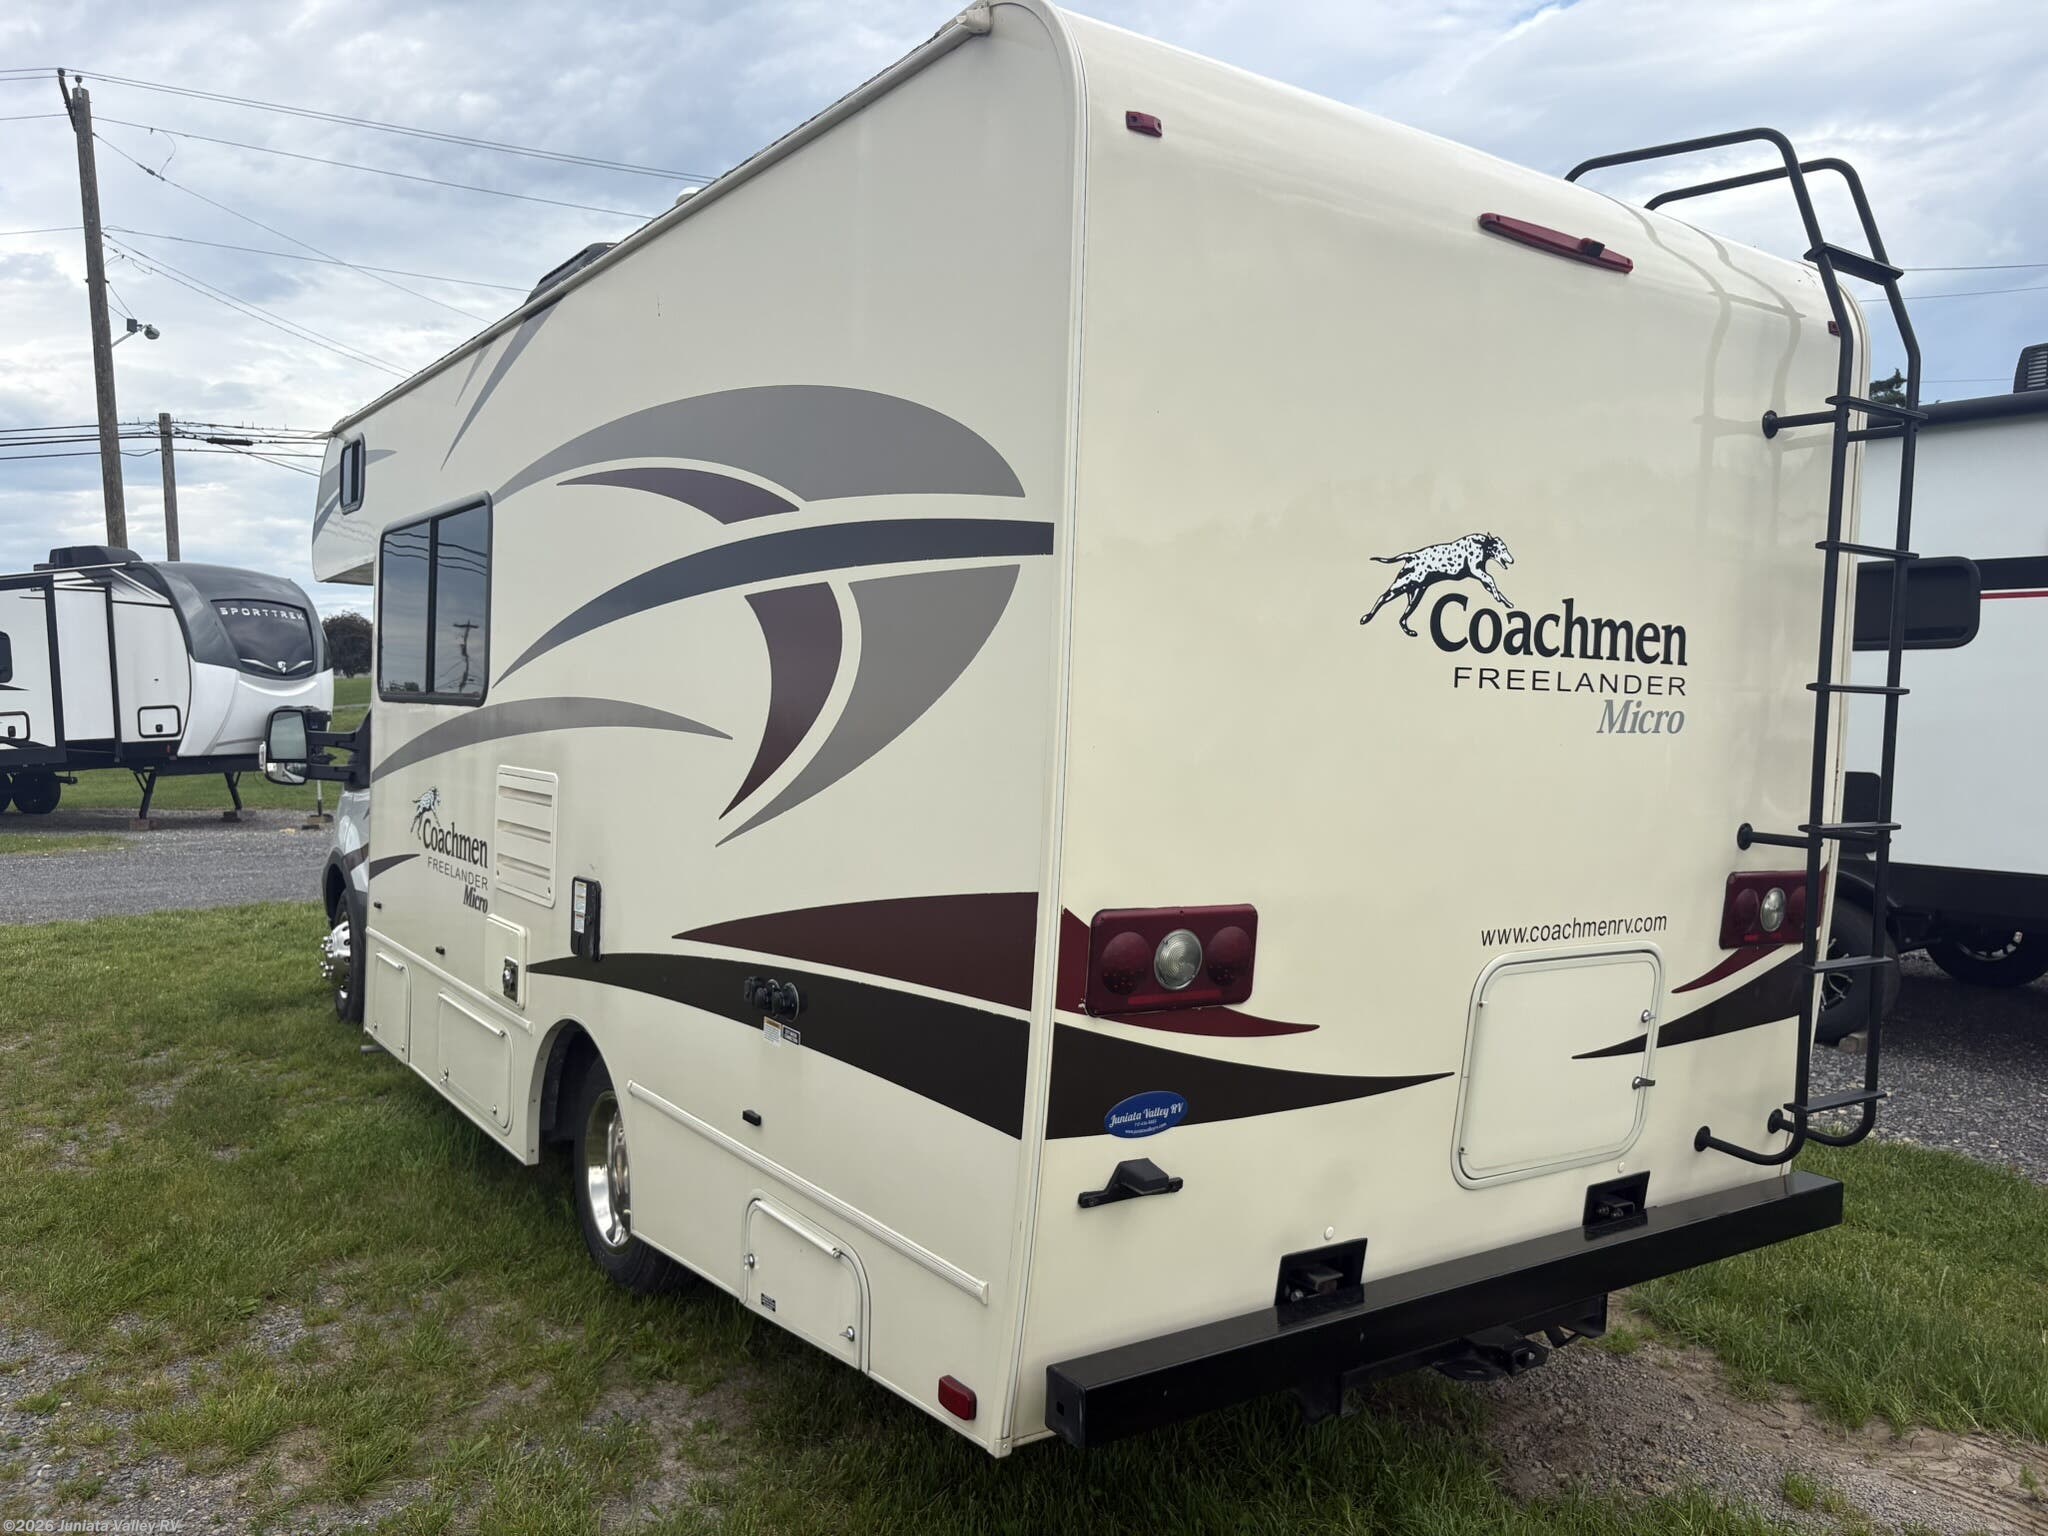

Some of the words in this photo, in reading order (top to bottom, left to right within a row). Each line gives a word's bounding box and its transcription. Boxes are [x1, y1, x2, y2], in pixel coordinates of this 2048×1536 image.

[220, 607, 304, 621] SPORTTREK
[1430, 592, 1688, 666] Coachmen
[1454, 667, 1686, 696] FREELANDER
[1596, 699, 1685, 734] Micro
[423, 818, 488, 869] Coachmen
[427, 856, 488, 890] FREELANDER
[463, 884, 488, 914] Micro
[1481, 915, 1667, 946] www.coachmenrv.com
[1109, 1112, 1142, 1128] Juniata
[1143, 1107, 1169, 1119] Valley
[1170, 1102, 1184, 1114] RV
